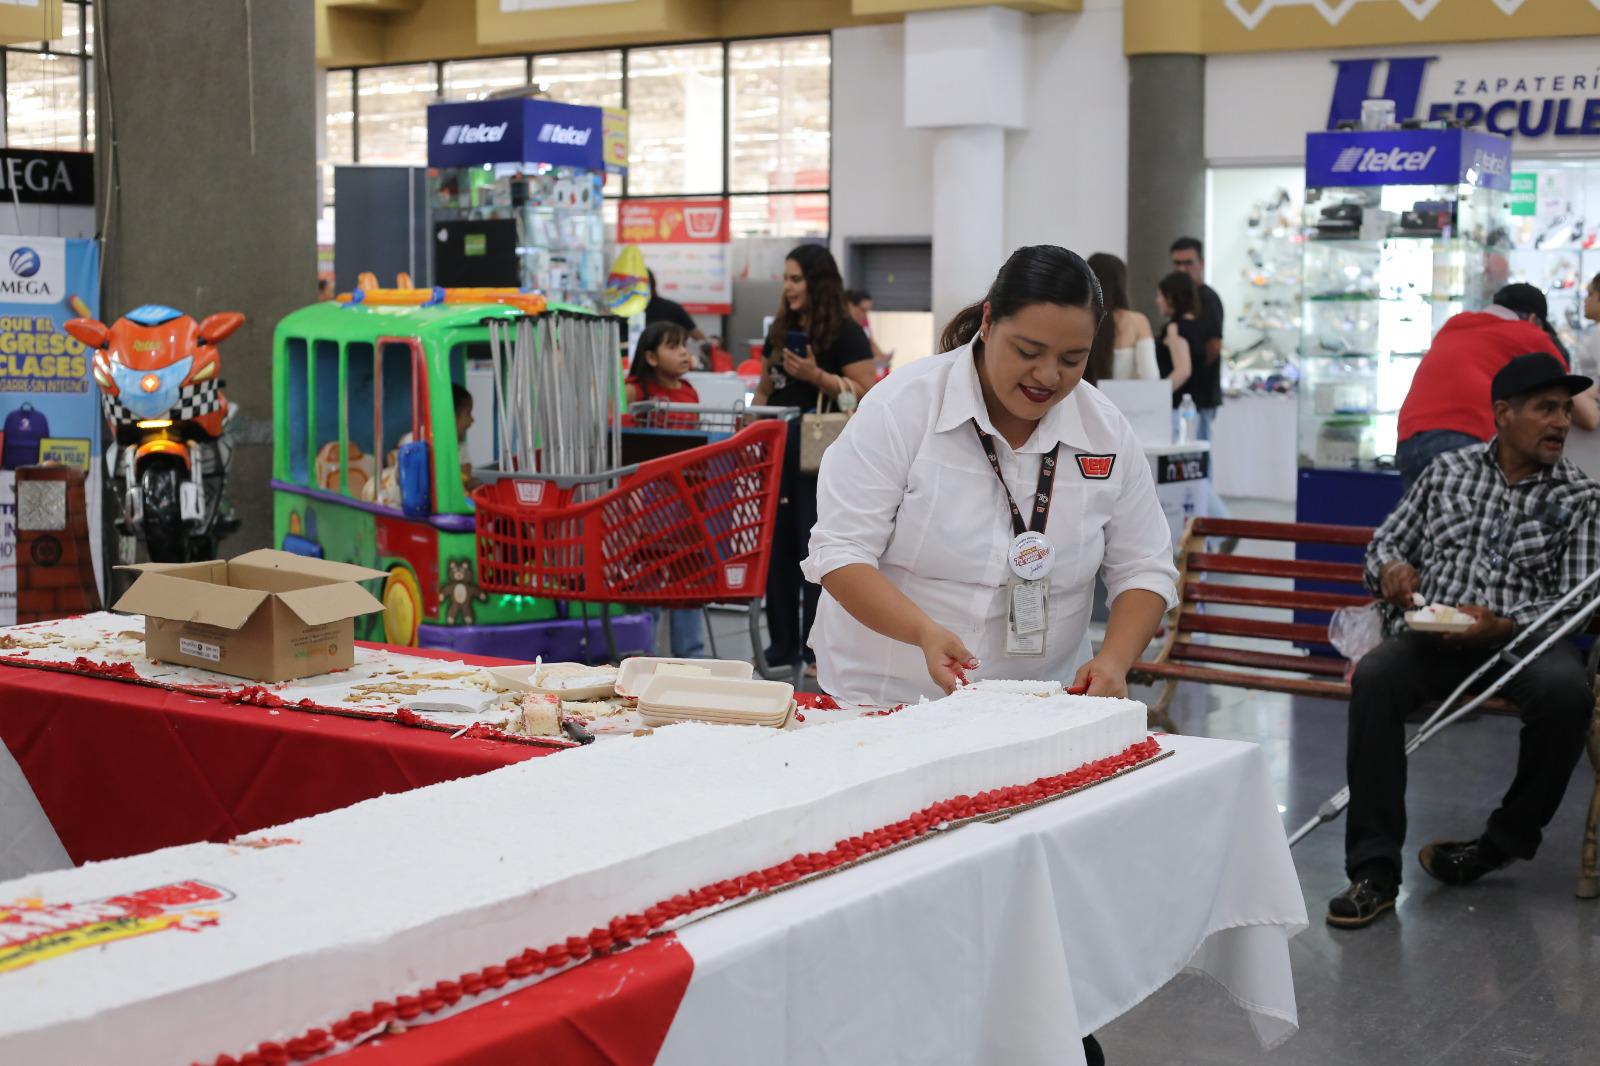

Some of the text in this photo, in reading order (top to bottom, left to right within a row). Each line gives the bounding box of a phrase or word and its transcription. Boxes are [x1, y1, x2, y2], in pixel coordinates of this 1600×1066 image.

[458, 121, 508, 145] telcel
[551, 124, 592, 146] telcel
[1358, 145, 1437, 173] telcel
[0, 280, 50, 295] MEGA
